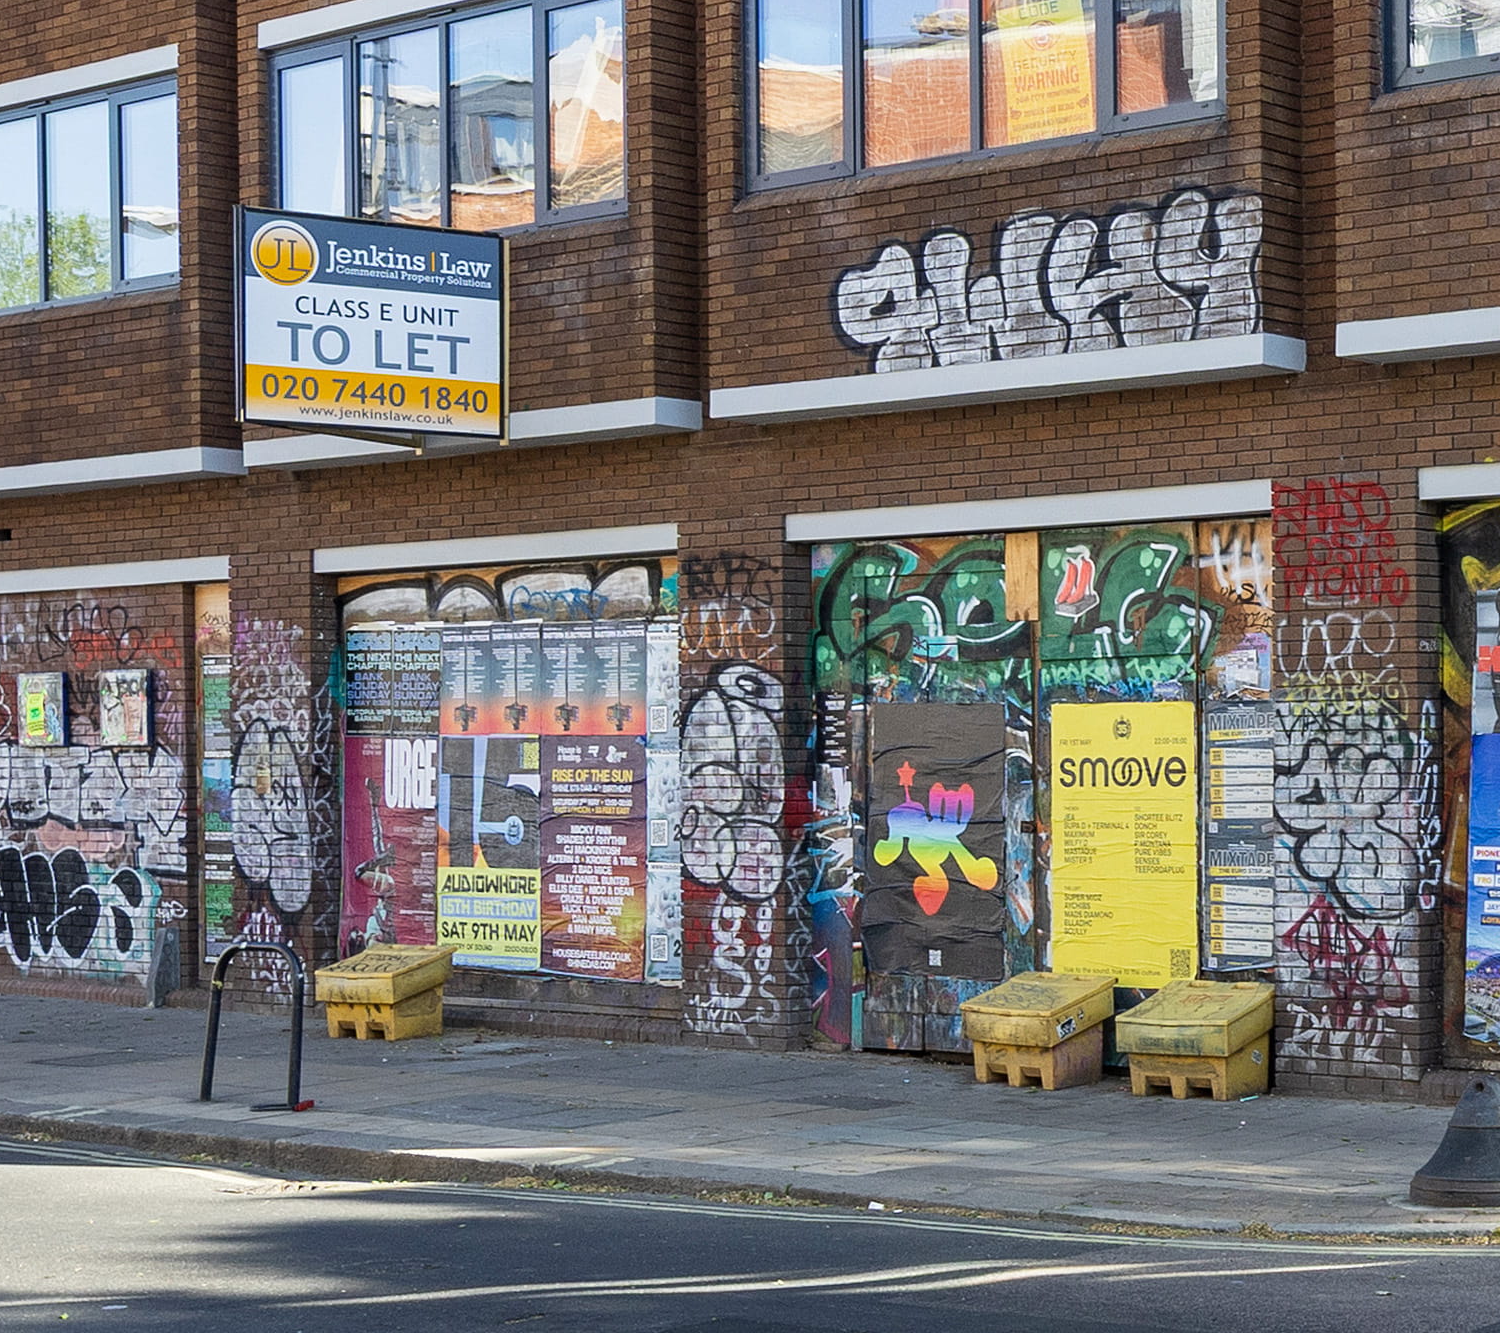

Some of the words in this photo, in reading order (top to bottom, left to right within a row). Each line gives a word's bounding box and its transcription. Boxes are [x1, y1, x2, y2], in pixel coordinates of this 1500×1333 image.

[325, 240, 426, 273] Jenkins
[439, 252, 492, 278] Law
[336, 264, 399, 281] Commercial
[400, 270, 446, 286] Property
[446, 274, 492, 289] Solutions
[295, 295, 370, 319] CLASS
[380, 303, 393, 322] E
[403, 305, 459, 327] UNIT
[277, 320, 350, 365] TO
[375, 329, 471, 374] LET
[262, 373, 319, 401] 020
[332, 378, 406, 407] 7440
[420, 386, 488, 414] 1840
[299, 405, 453, 426] www.jenkinslaw.co.uk
[346, 662, 392, 671] CHAPTER
[347, 653, 365, 662] THE
[367, 653, 391, 662] NEXT
[347, 682, 391, 691] HOLIDAY
[354, 673, 384, 681] BANK
[347, 690, 391, 700] SUNDAY
[384, 738, 438, 810] URGE
[551, 768, 575, 783] RISE
[575, 768, 590, 783] OF
[590, 768, 611, 783] THE
[611, 768, 634, 783] SUN
[1059, 756, 1187, 788] smoove
[555, 834, 585, 845] SHADES
[585, 835, 596, 845] OF
[441, 874, 538, 896] AUDIOWHORE
[442, 897, 471, 916] 15TH
[473, 898, 536, 920] BIRTHDAY
[441, 921, 468, 939] SAT
[471, 922, 499, 941] 9TH
[504, 924, 538, 942] MAY
